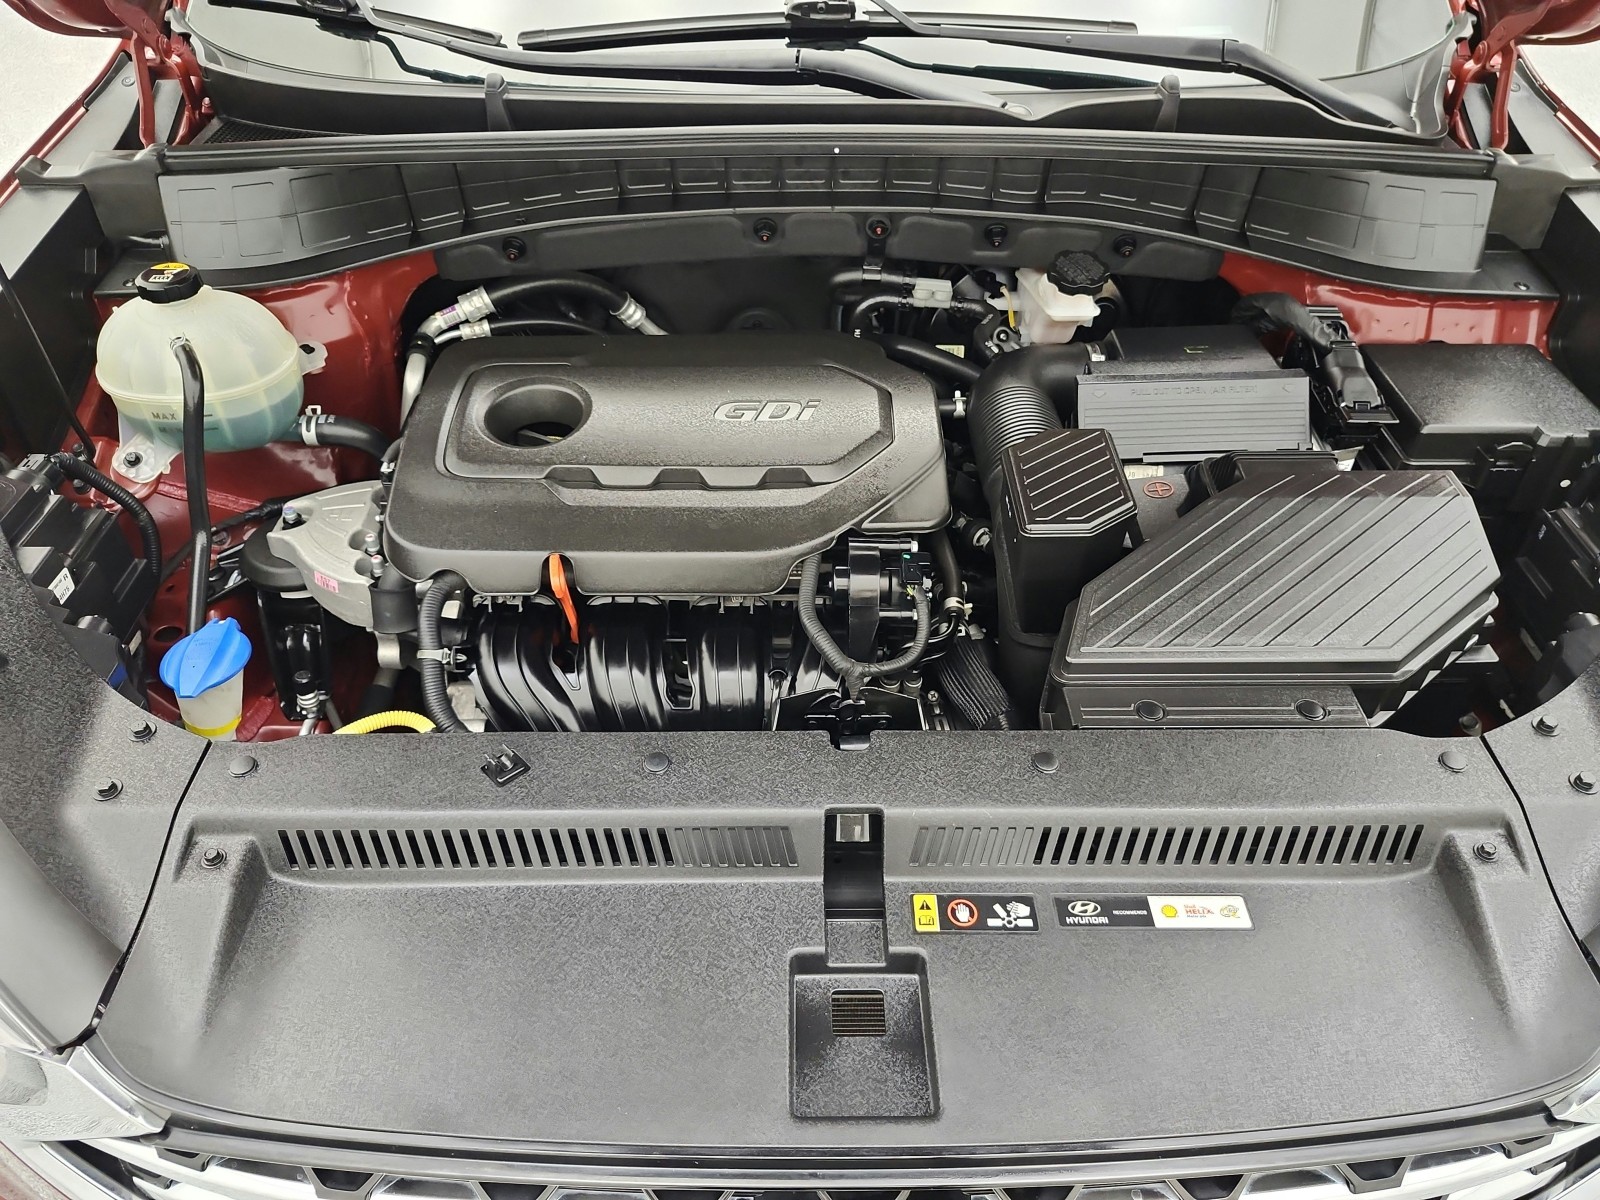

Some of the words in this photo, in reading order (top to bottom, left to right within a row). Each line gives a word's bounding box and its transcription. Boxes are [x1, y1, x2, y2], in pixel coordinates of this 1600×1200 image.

[1131, 388, 1151, 396] PULL
[1153, 387, 1169, 395] OUT
[1170, 387, 1182, 395] TO
[1184, 386, 1206, 394] OPEN
[713, 399, 821, 420] GDi
[151, 412, 177, 421] MAX
[1065, 916, 1109, 924] HYUNDAI
